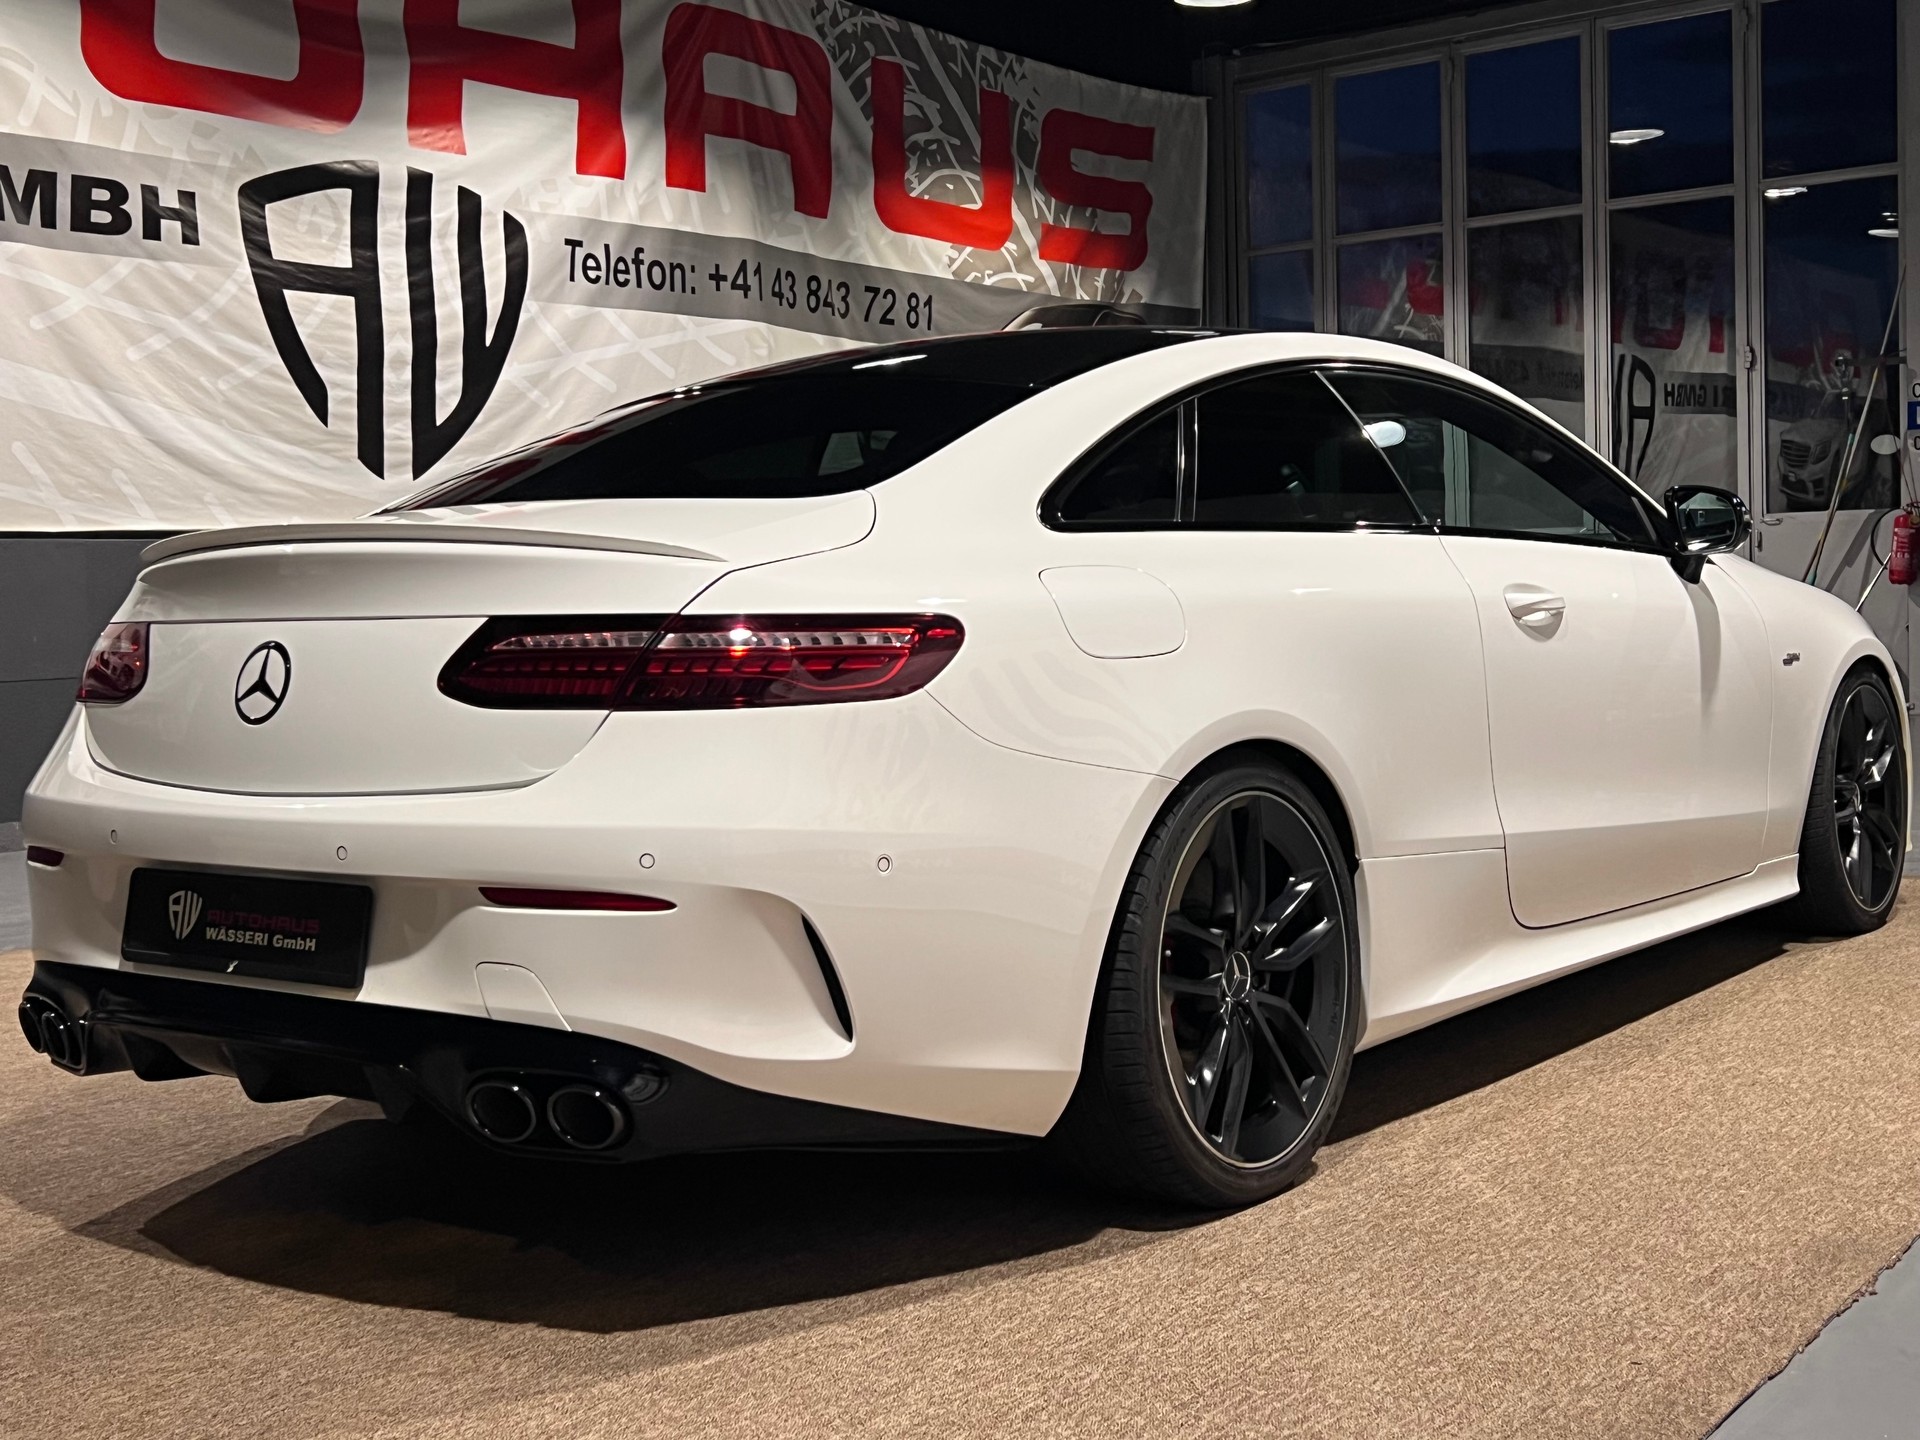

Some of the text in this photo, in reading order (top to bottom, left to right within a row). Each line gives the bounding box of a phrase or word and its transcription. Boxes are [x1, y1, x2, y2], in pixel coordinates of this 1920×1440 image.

[0, 164, 200, 246] MBH
[564, 237, 932, 331] Telefon: +41 43 843 72 81
[205, 925, 317, 951] WÄSSERI GmbH
[207, 909, 320, 934] AUTOHAUS
